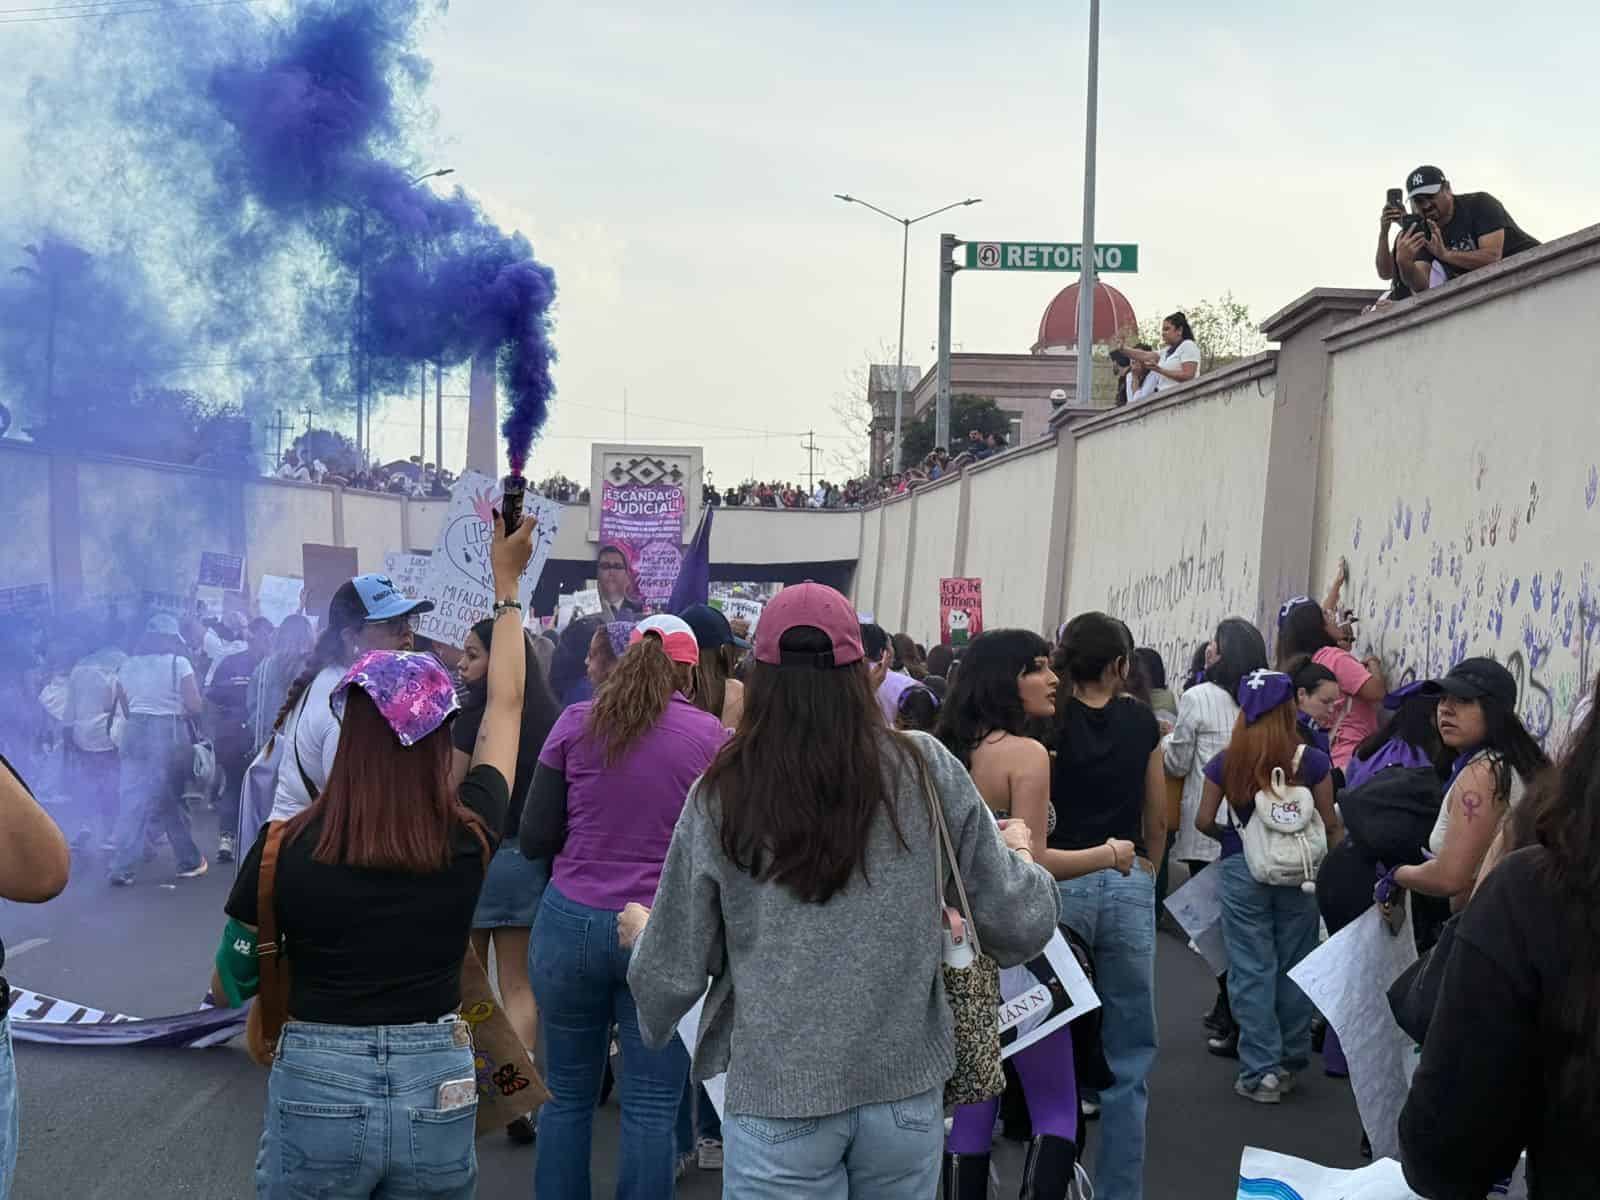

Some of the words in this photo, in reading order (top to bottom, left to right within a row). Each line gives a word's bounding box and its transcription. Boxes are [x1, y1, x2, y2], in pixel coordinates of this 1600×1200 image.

[1412, 173, 1424, 187] NY
[1007, 245, 1122, 268] RETORNO
[610, 499, 680, 515] JUDICIAL!
